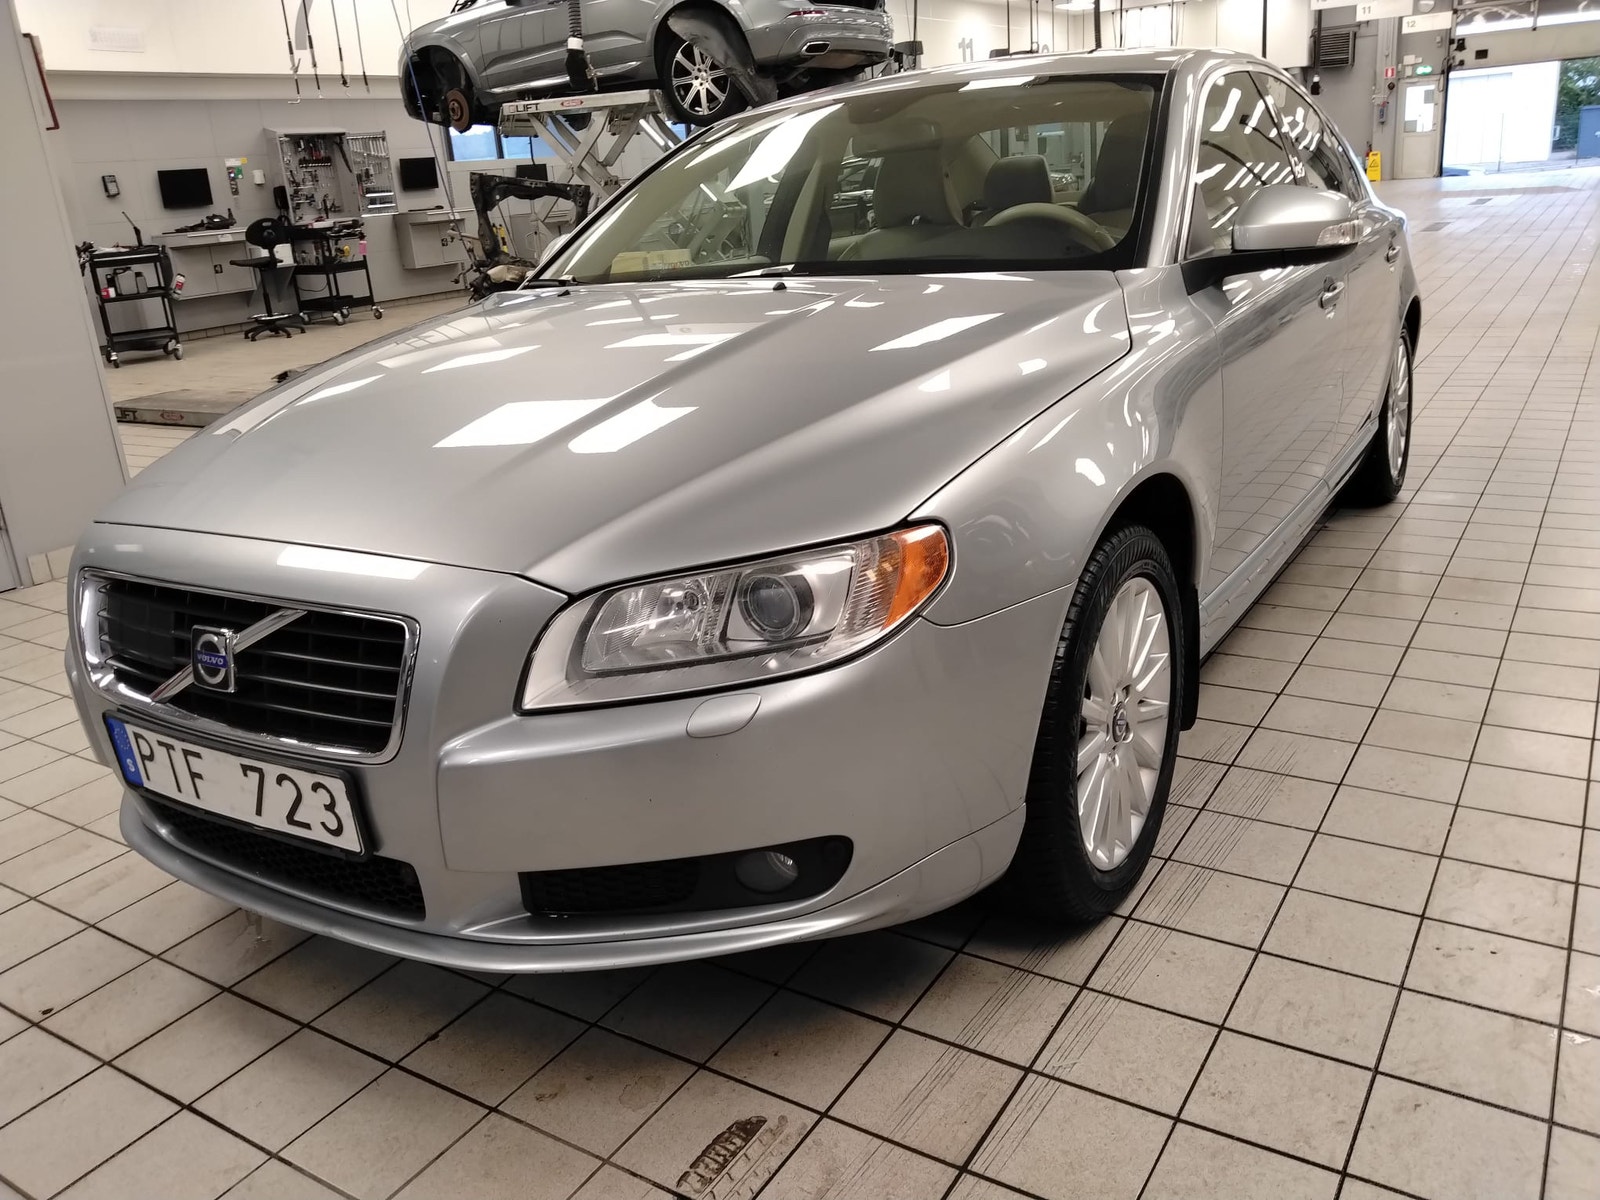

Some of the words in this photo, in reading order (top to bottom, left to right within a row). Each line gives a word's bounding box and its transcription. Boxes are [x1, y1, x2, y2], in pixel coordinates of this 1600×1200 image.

[1361, 5, 1373, 15] 11
[1405, 20, 1416, 28] 12
[958, 37, 974, 62] 11
[196, 653, 225, 666] VOLVO
[126, 757, 136, 773] S
[131, 731, 205, 800] PTF
[240, 762, 345, 838] 723
